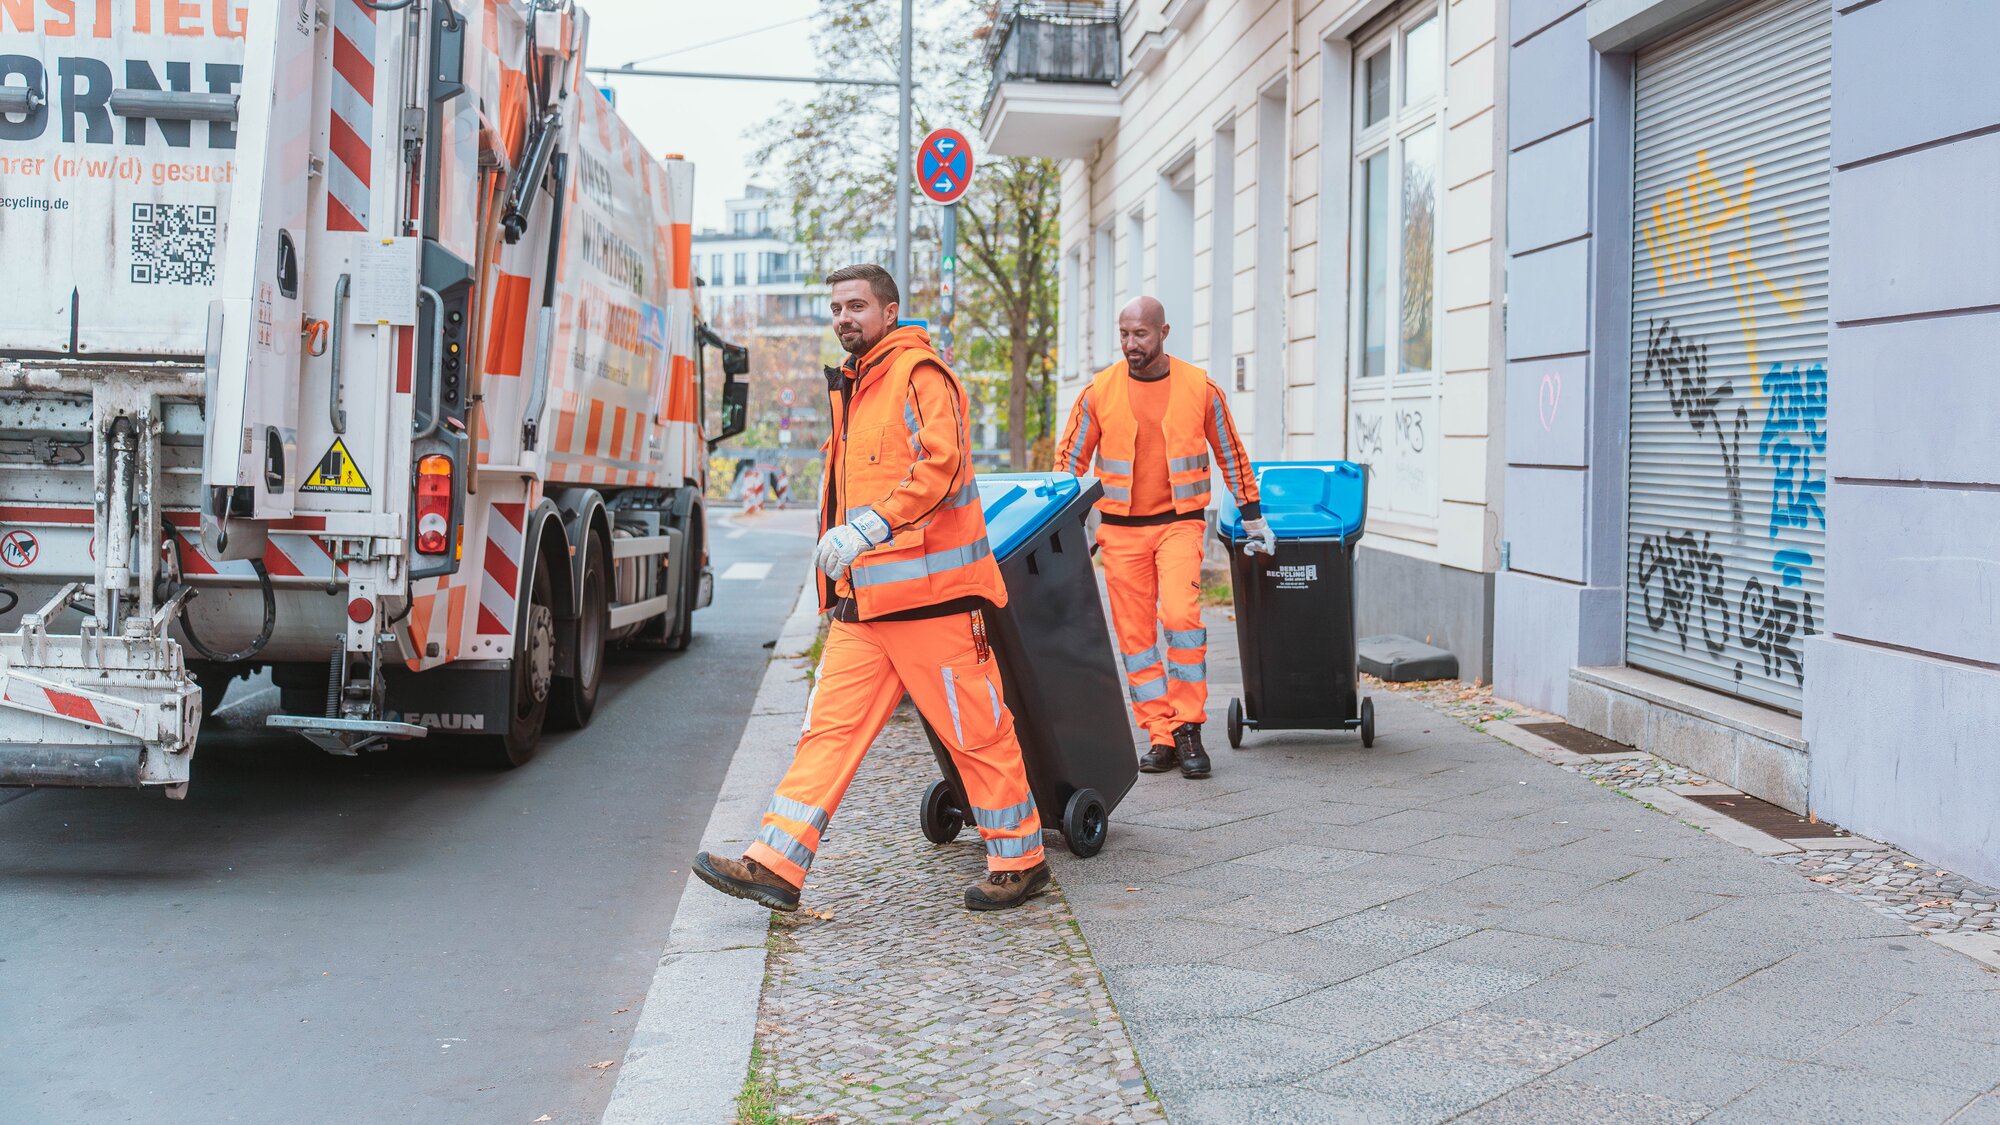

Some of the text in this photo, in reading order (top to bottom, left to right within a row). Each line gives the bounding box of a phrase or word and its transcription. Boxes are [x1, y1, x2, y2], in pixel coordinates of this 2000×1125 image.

[579, 143, 614, 218] UNSER
[0, 196, 69, 211] ecycling.de
[581, 208, 644, 297] WICHTIGSTER
[1266, 570, 1306, 578] RECYCLING
[403, 712, 484, 730] FAUN
